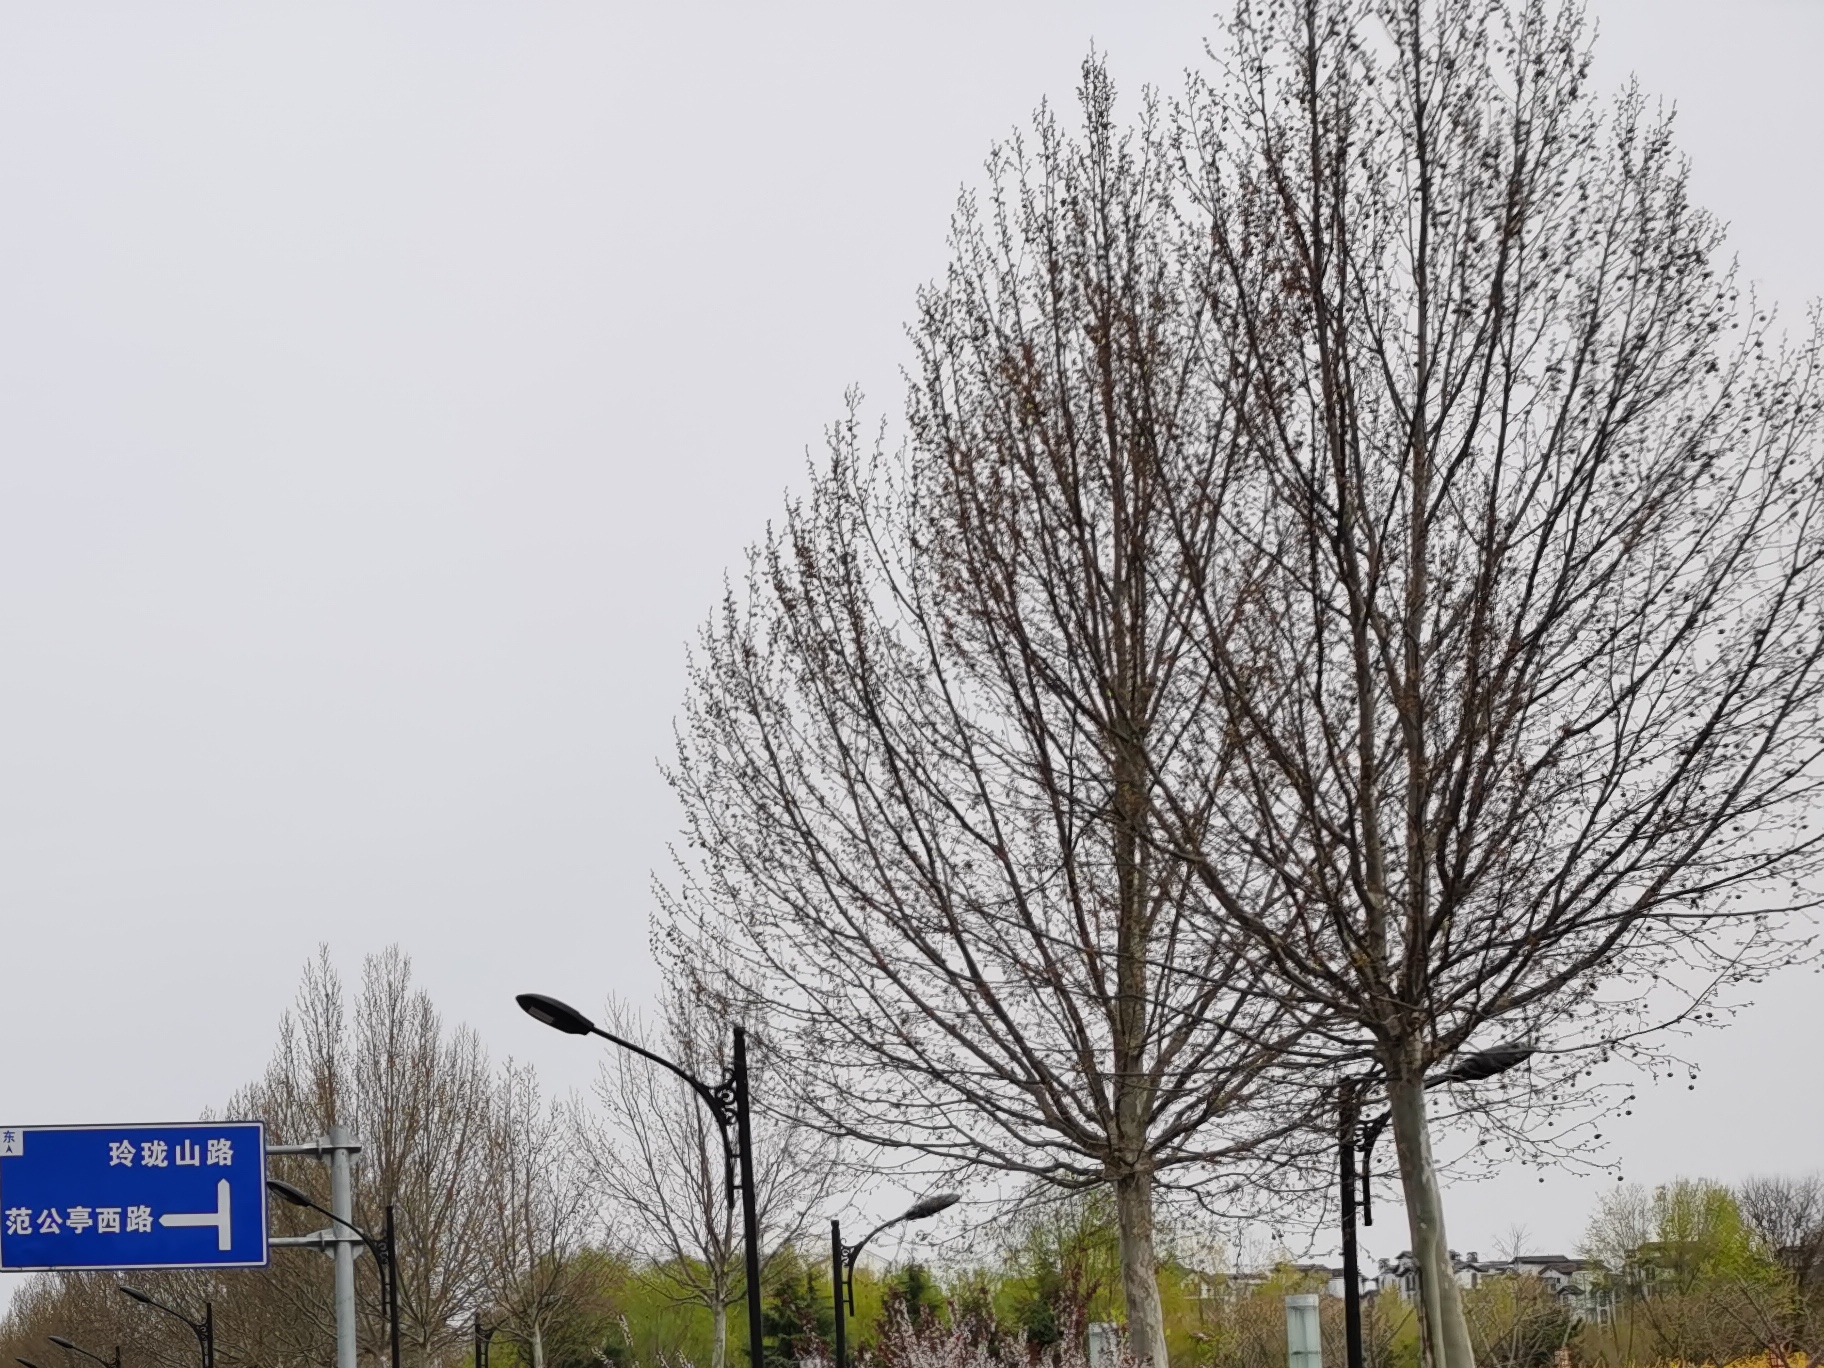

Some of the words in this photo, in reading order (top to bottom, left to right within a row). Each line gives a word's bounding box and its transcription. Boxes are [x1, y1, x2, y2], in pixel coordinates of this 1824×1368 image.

[3, 1130, 15, 1143] 东
[109, 1138, 234, 1168] 玲珑山路
[5, 1205, 154, 1235] 范公亭西路
